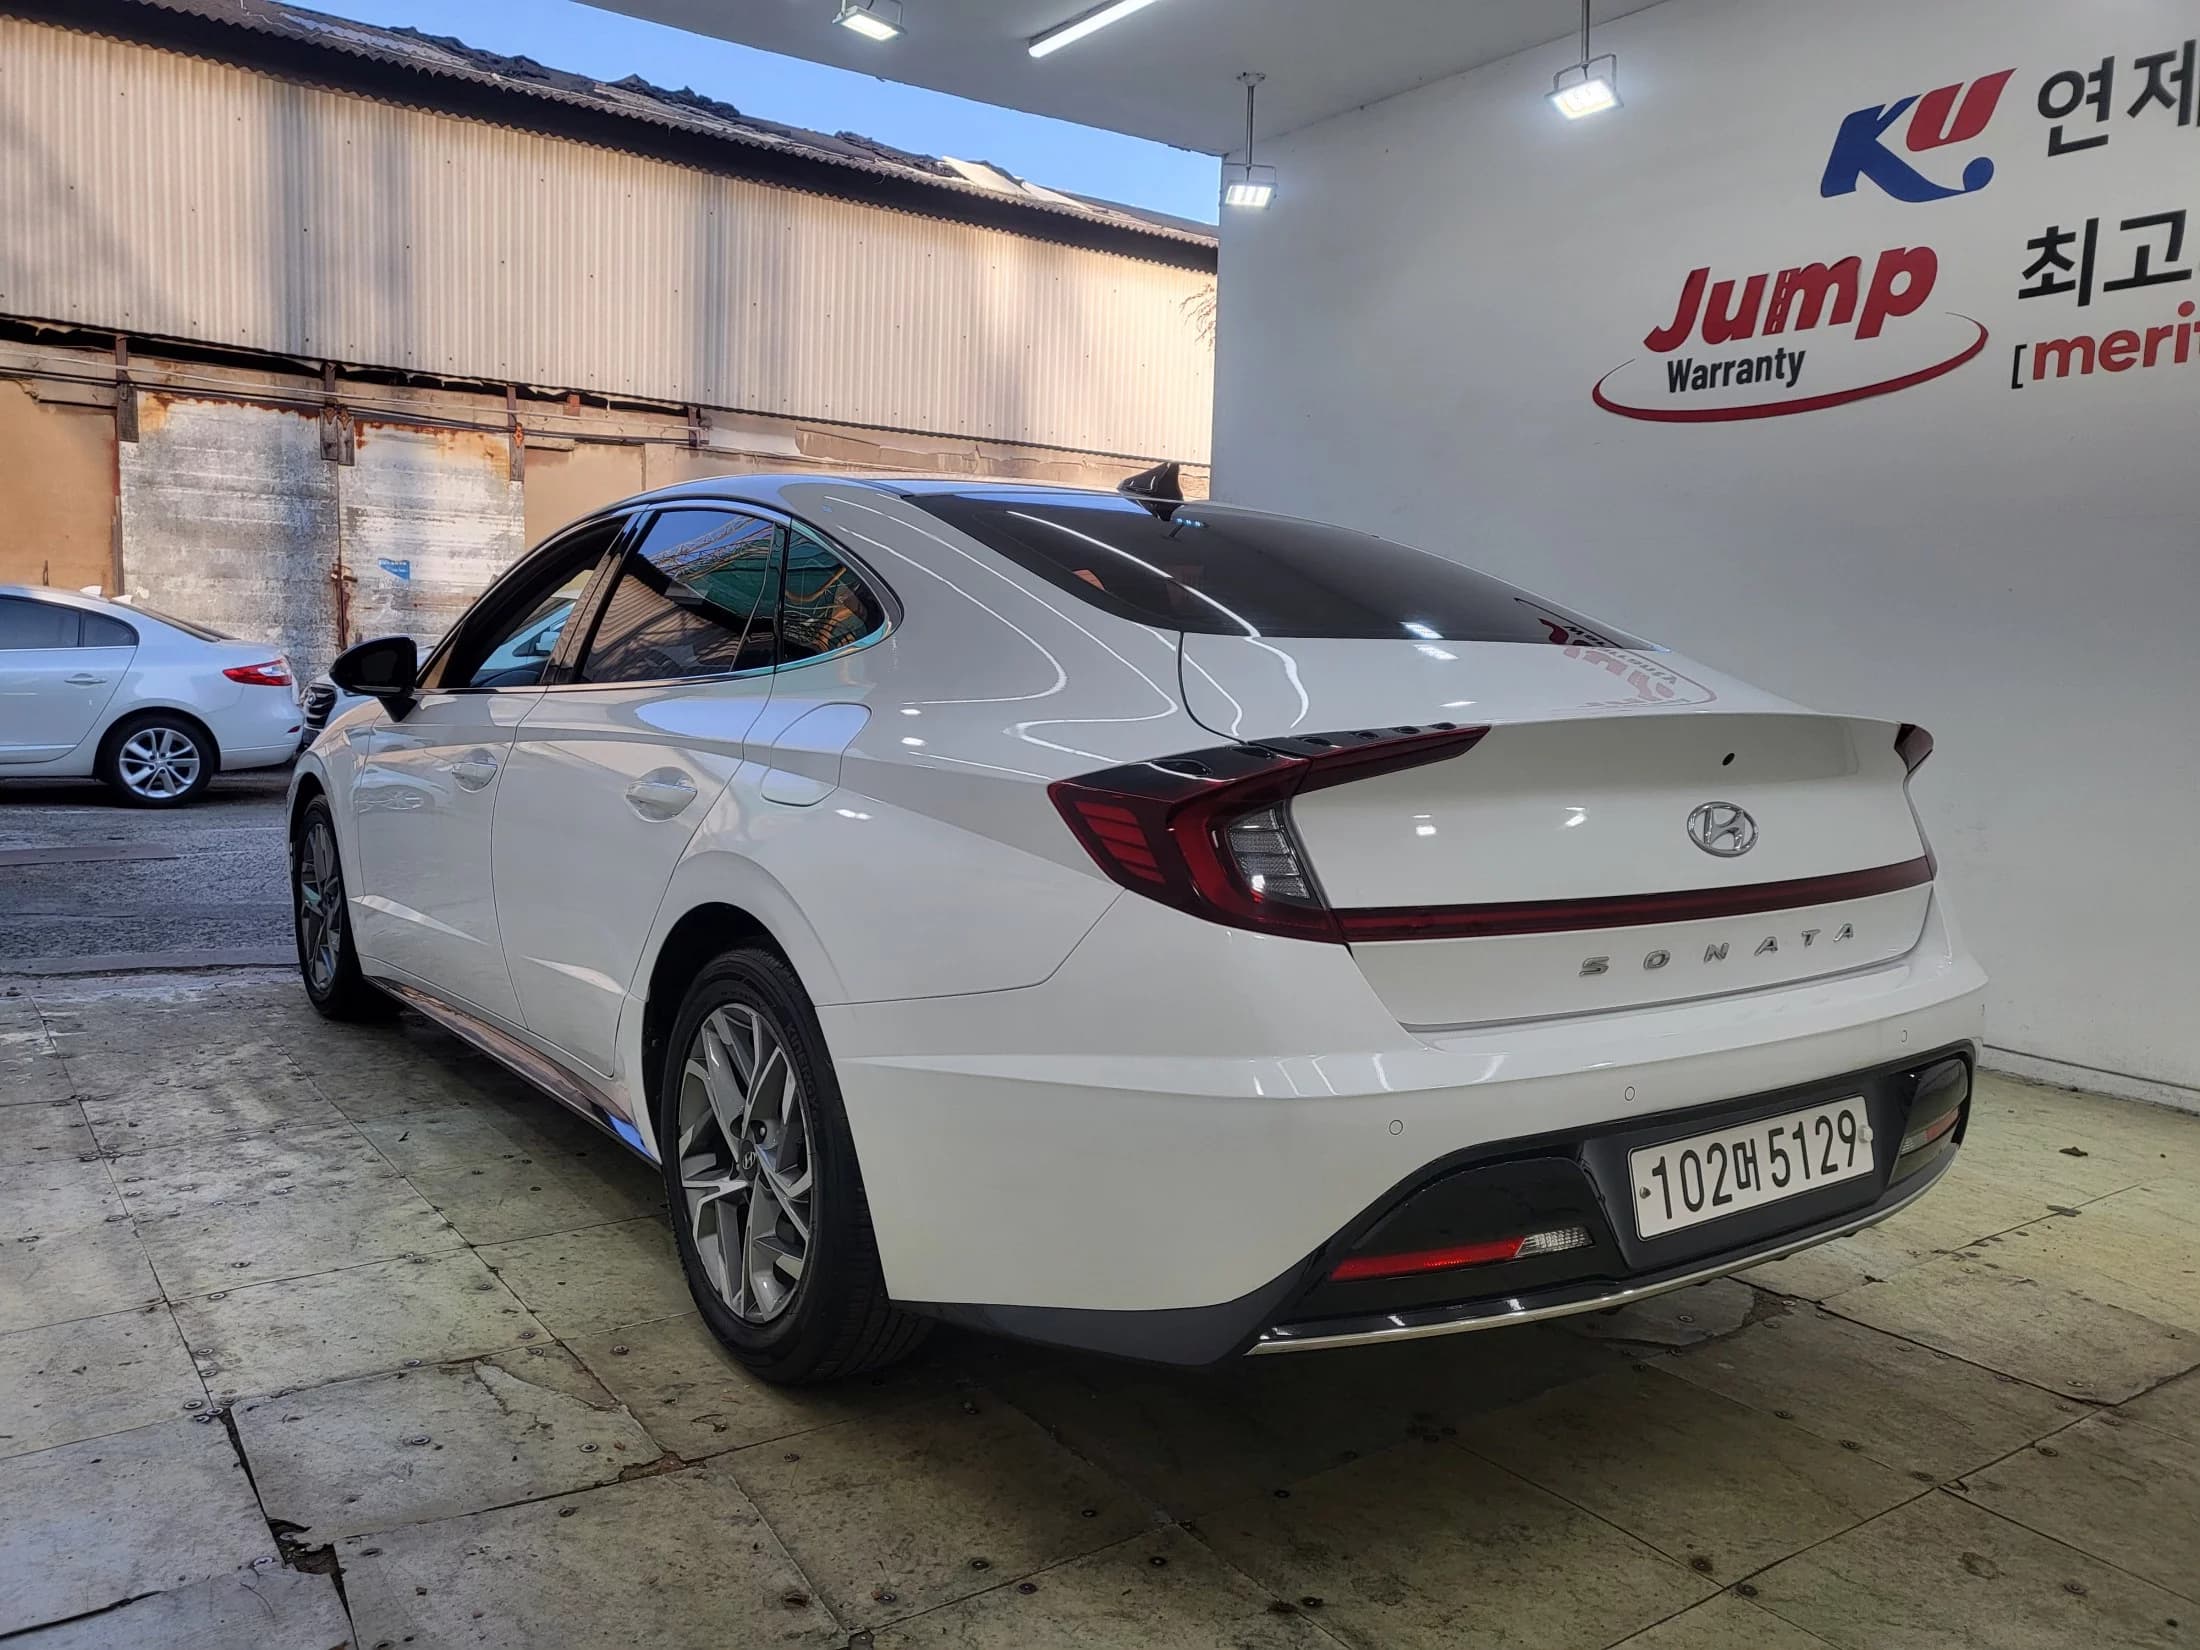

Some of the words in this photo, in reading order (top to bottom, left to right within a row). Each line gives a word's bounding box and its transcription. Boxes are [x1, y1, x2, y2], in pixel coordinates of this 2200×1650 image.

[2018, 209, 2193, 307] 최고
[1645, 246, 1938, 352] Jump
[1667, 347, 1806, 393] Warranty
[1579, 922, 1854, 976] SONATA
